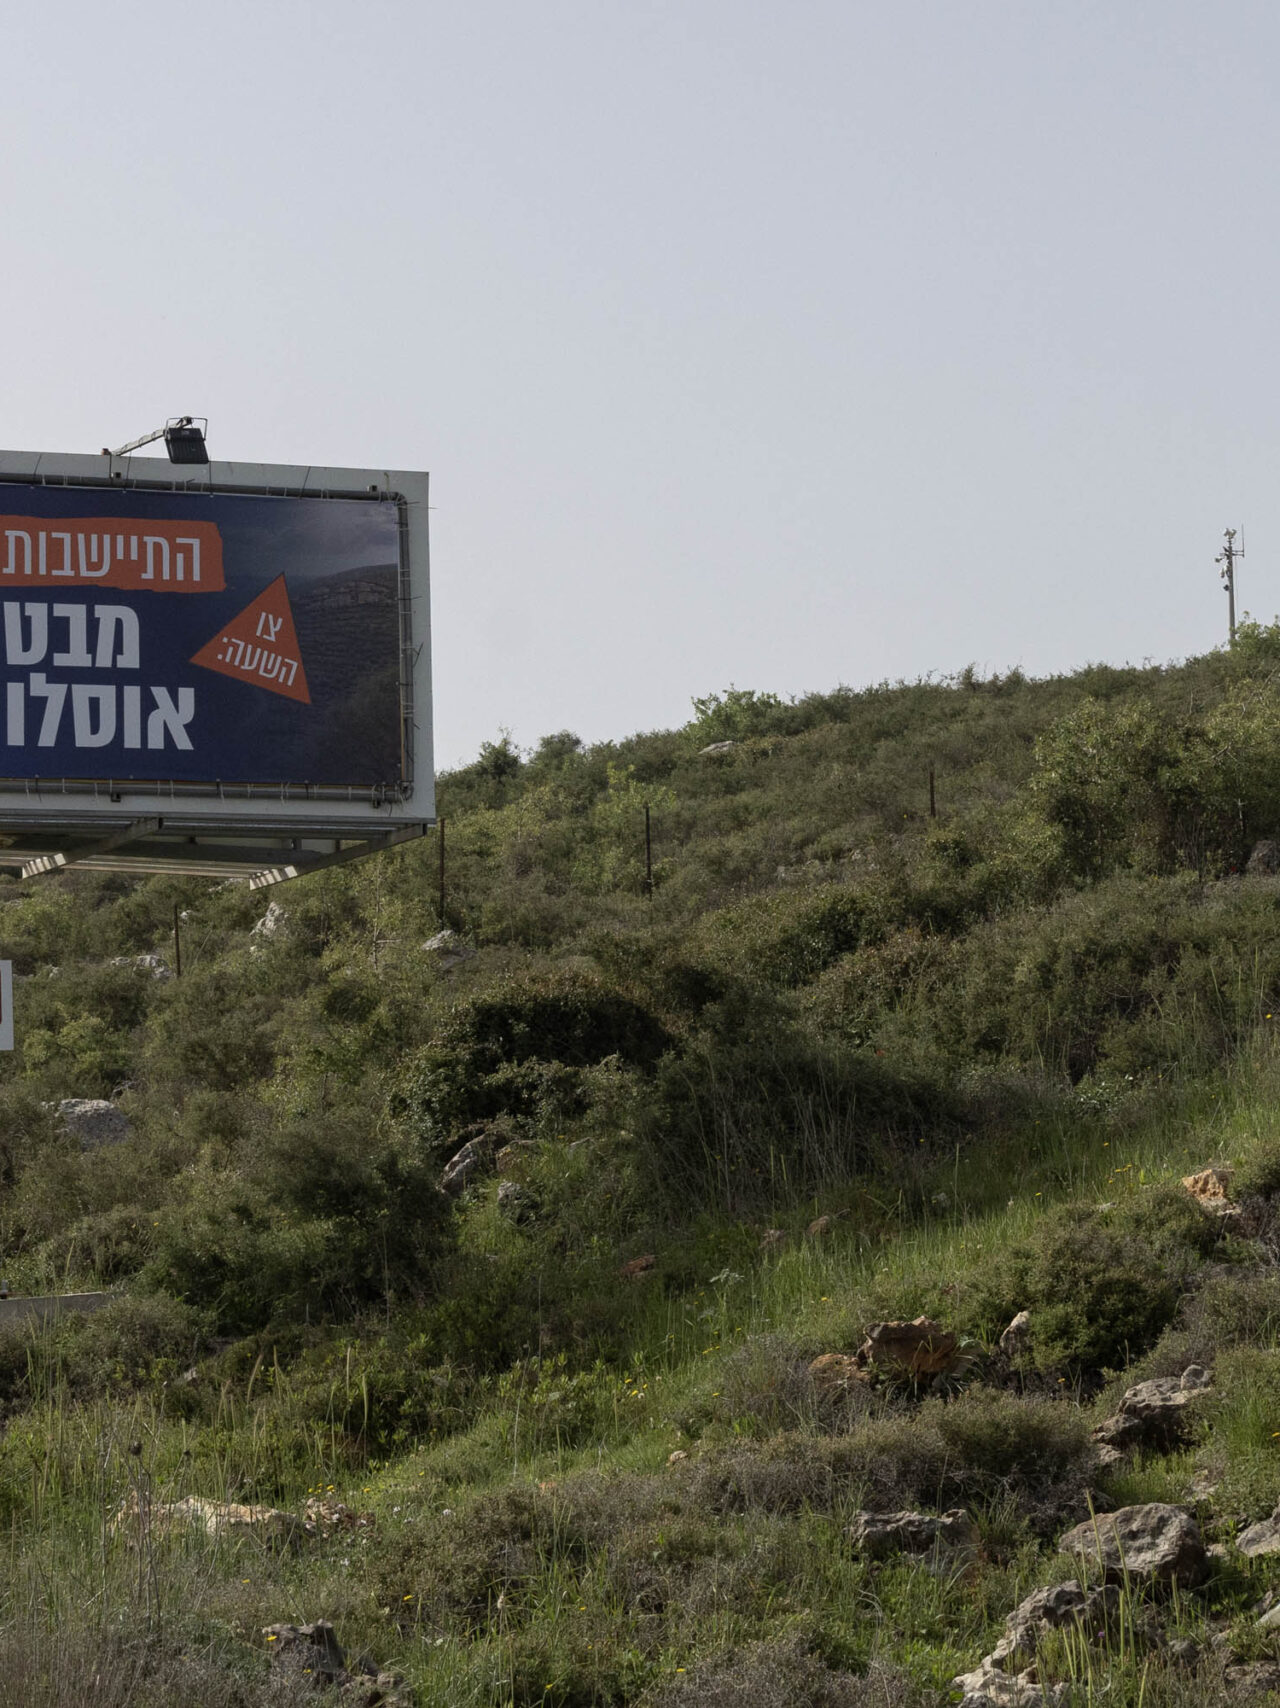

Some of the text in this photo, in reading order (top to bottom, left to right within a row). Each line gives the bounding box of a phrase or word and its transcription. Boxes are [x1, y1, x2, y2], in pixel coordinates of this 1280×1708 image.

[3, 528, 201, 582] התיישבות
[255, 611, 284, 642] צו
[216, 636, 299, 687] השעה:
[6, 672, 196, 751] אוסלו
